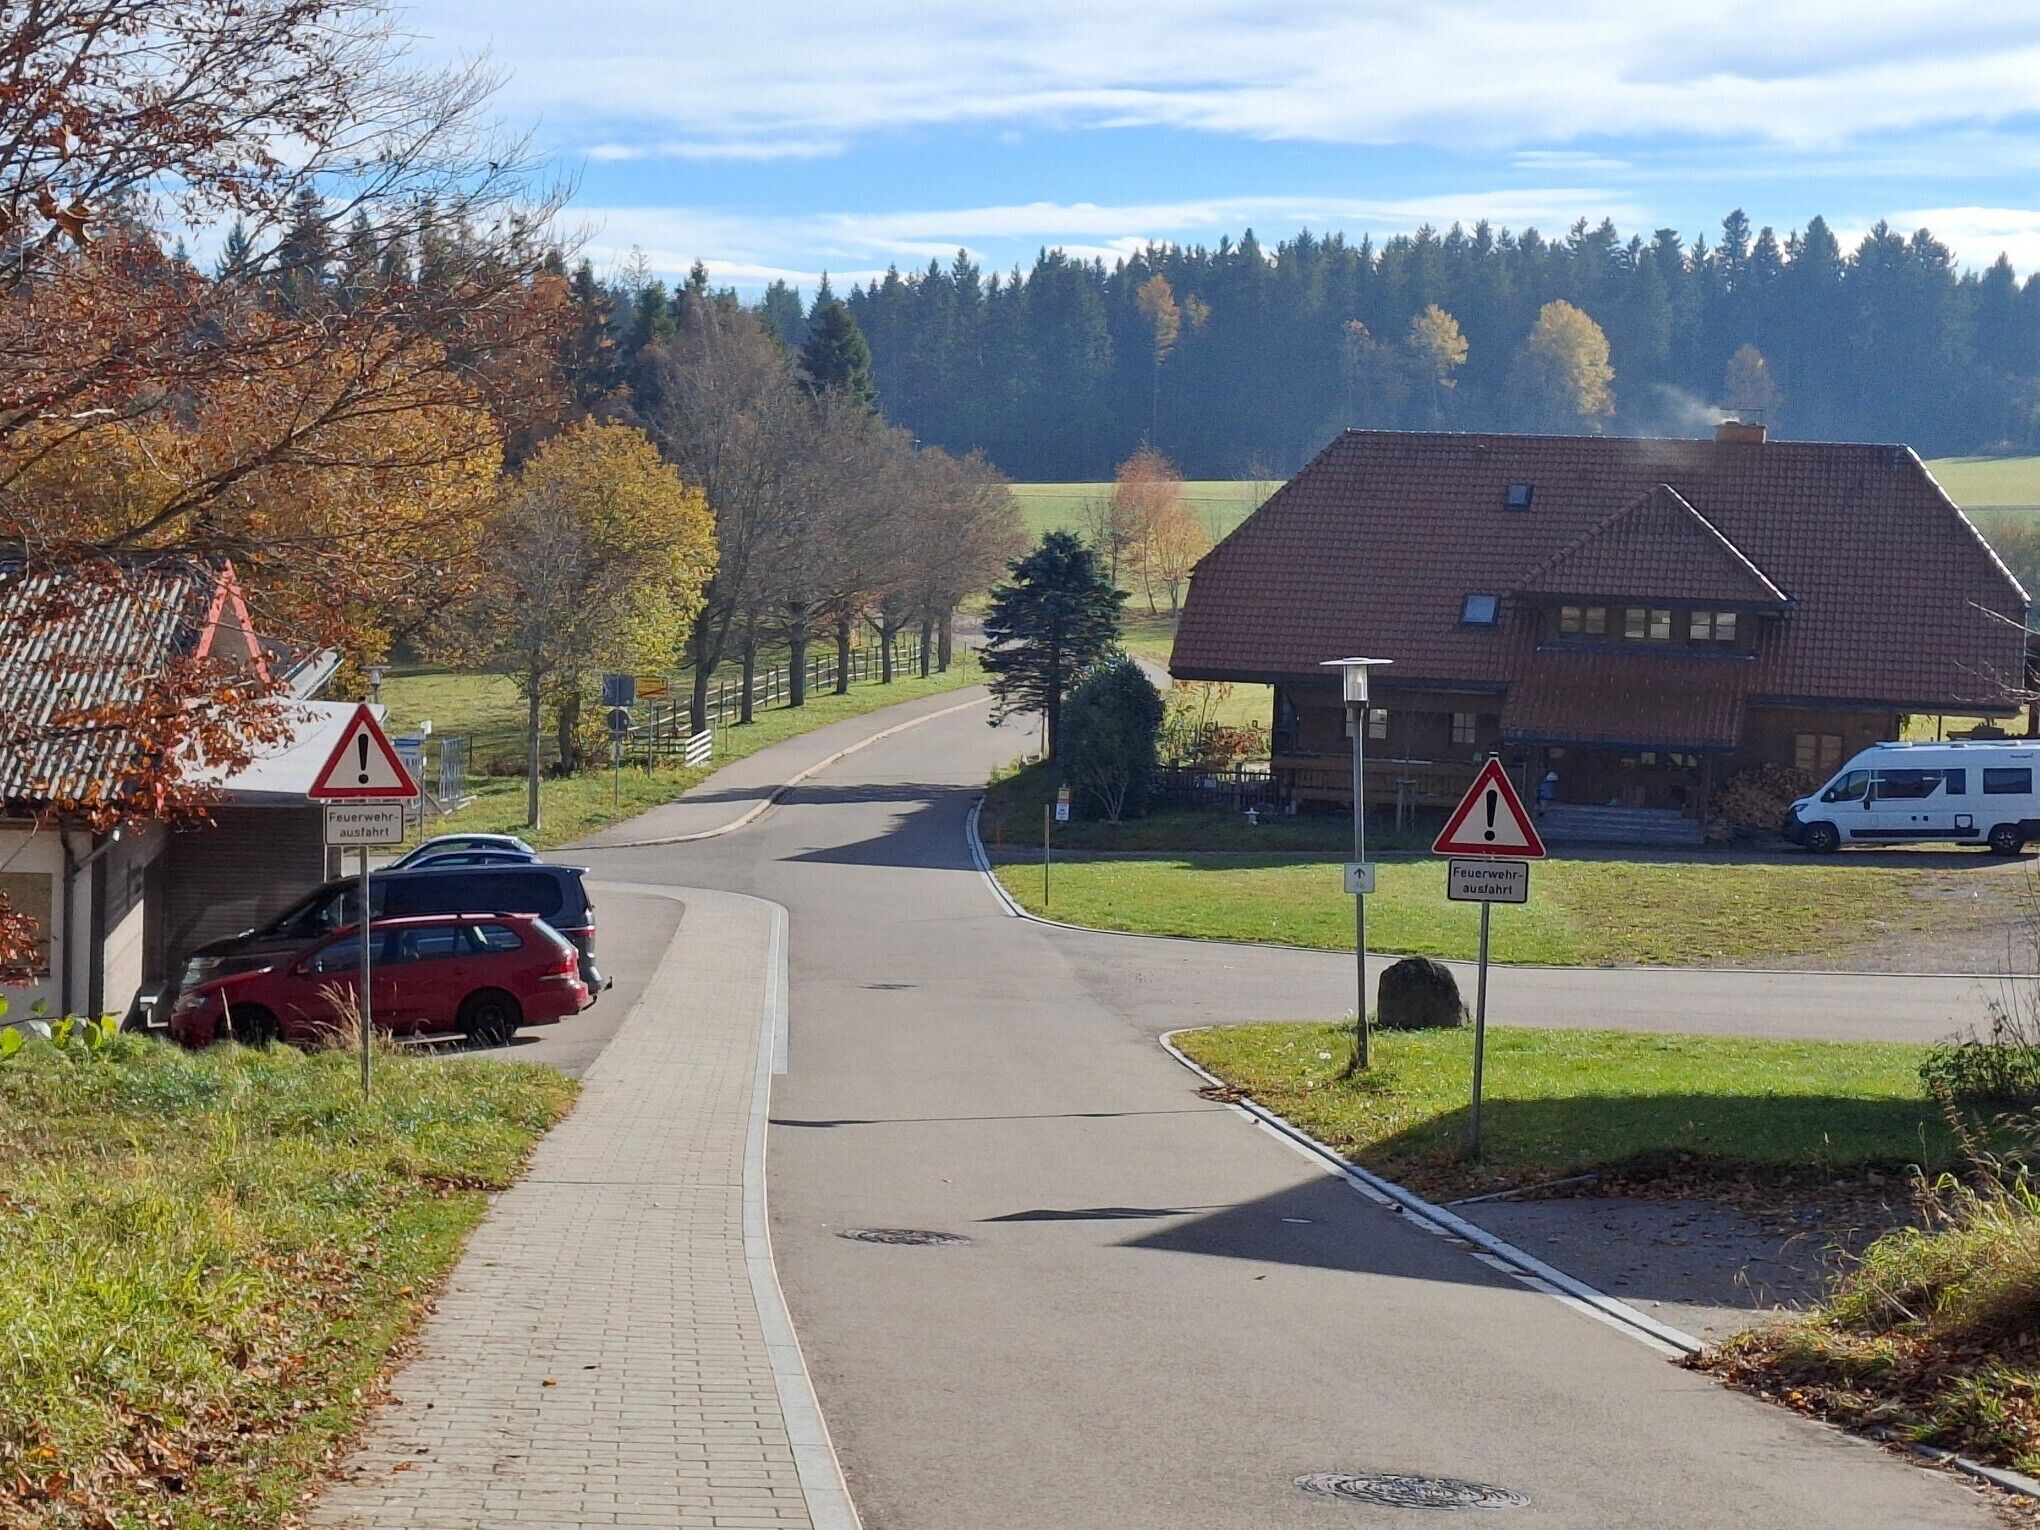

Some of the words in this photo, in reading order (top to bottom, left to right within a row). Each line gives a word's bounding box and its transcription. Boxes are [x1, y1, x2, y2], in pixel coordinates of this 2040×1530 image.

[329, 812, 399, 823] Feuerwehr-
[340, 827, 389, 838] ausfahrt
[1453, 867, 1523, 880] Feuerwehr-
[1463, 884, 1512, 895] ausfahrt
